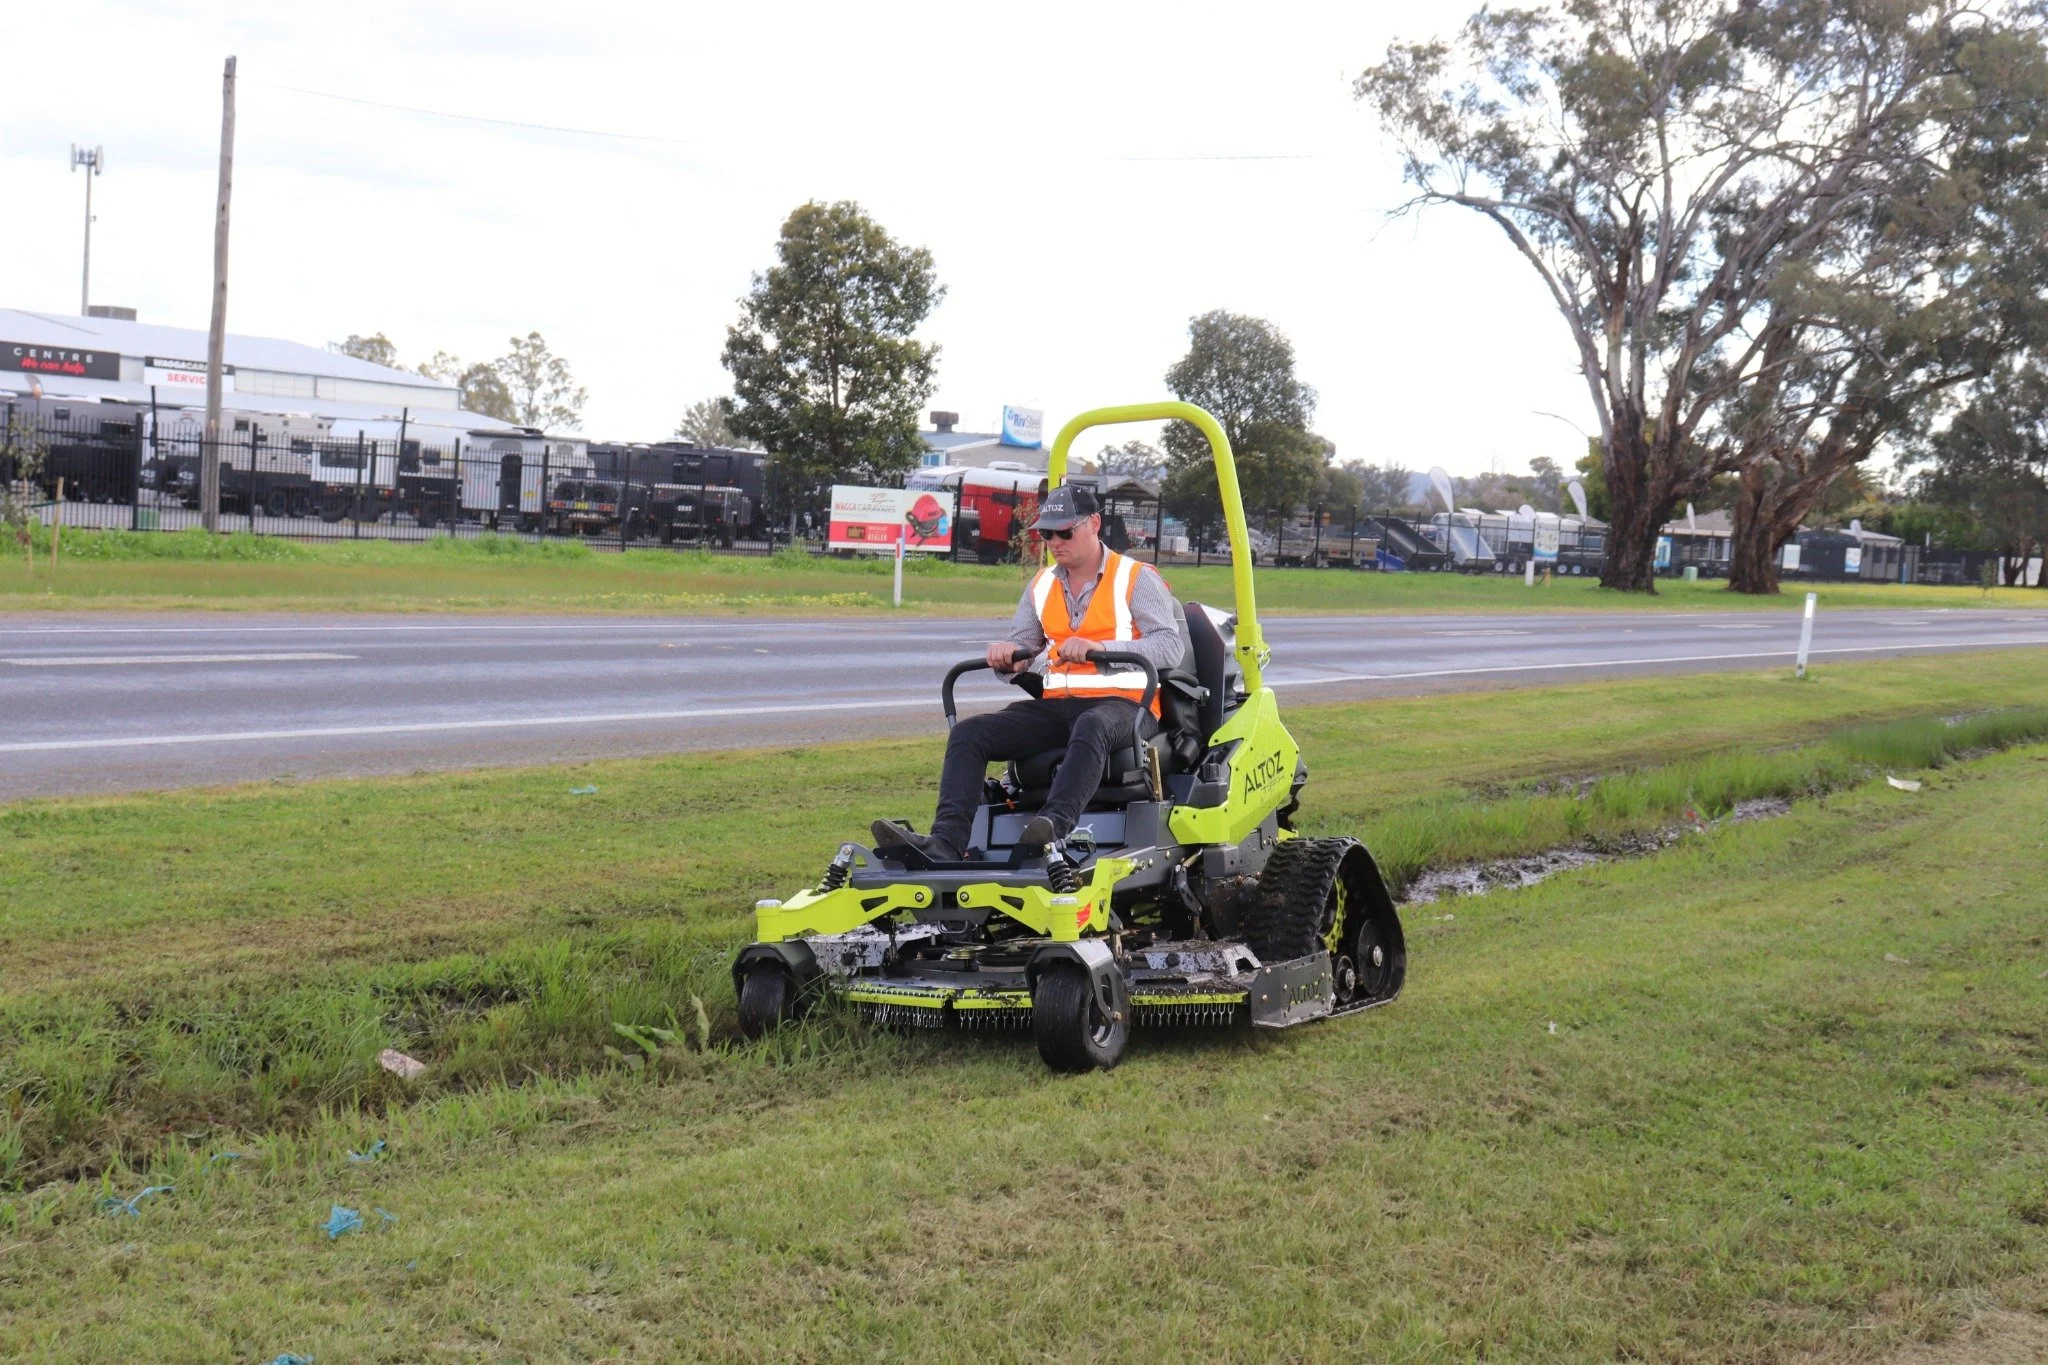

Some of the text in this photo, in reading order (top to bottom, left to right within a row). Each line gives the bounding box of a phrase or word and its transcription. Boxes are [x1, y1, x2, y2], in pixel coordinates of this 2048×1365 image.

[13, 346, 94, 364] CENTRE
[834, 502, 896, 513] WAGGA CARAVANS
[1244, 749, 1285, 804] ALTOZ
